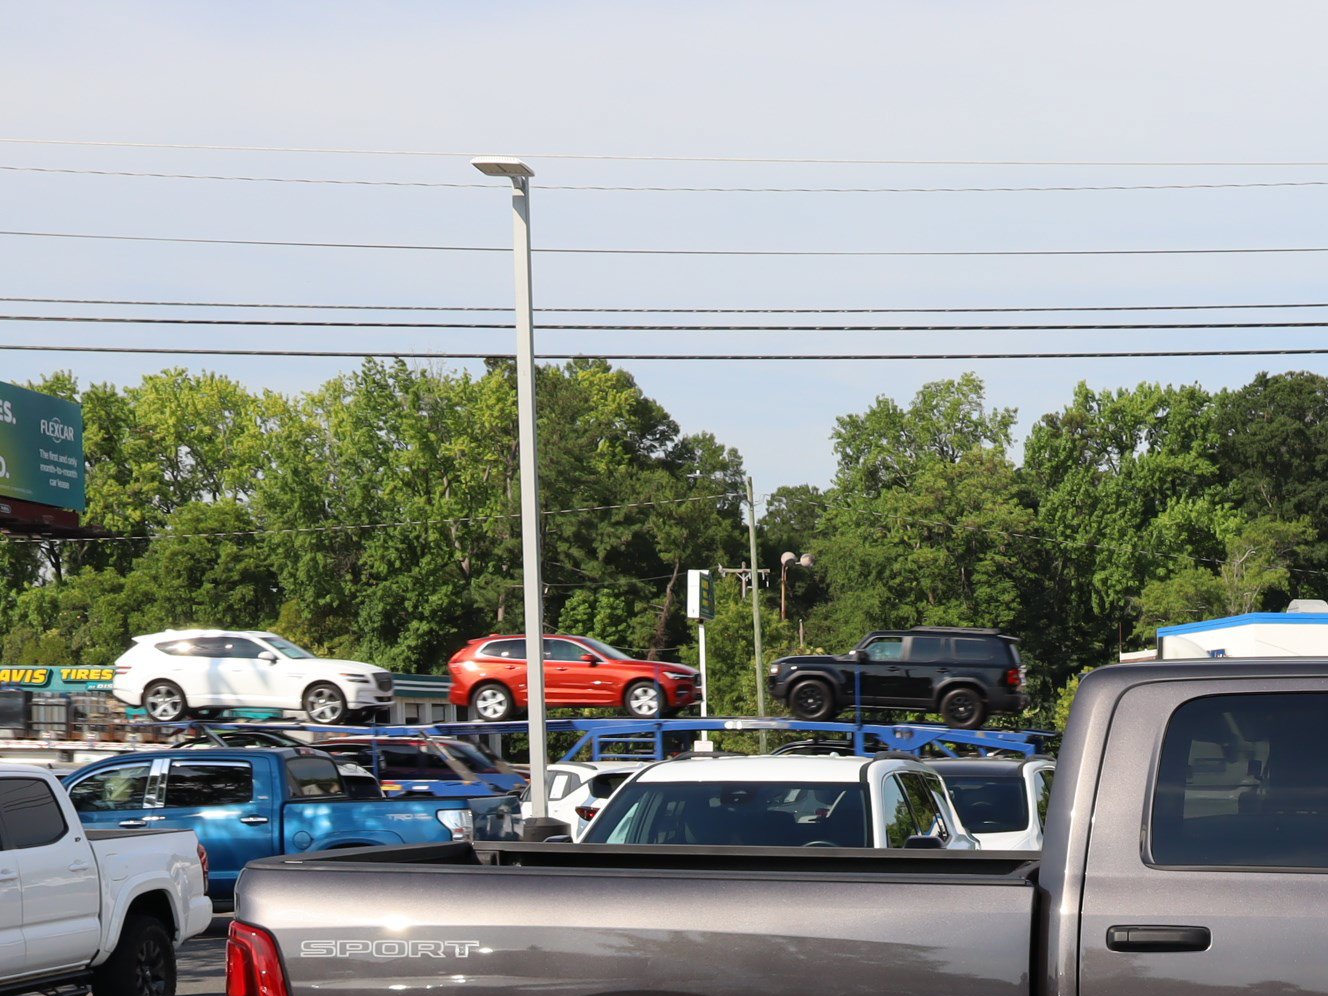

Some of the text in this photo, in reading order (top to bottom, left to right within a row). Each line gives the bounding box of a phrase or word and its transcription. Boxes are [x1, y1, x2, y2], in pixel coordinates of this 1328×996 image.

[40, 419, 75, 441] FLEXCAR
[40, 449, 78, 468] The first and only
[40, 464, 78, 478] month-to-month
[49, 478, 70, 489] car lease
[60, 669, 114, 680] TIRES
[300, 940, 480, 958] SPORT
